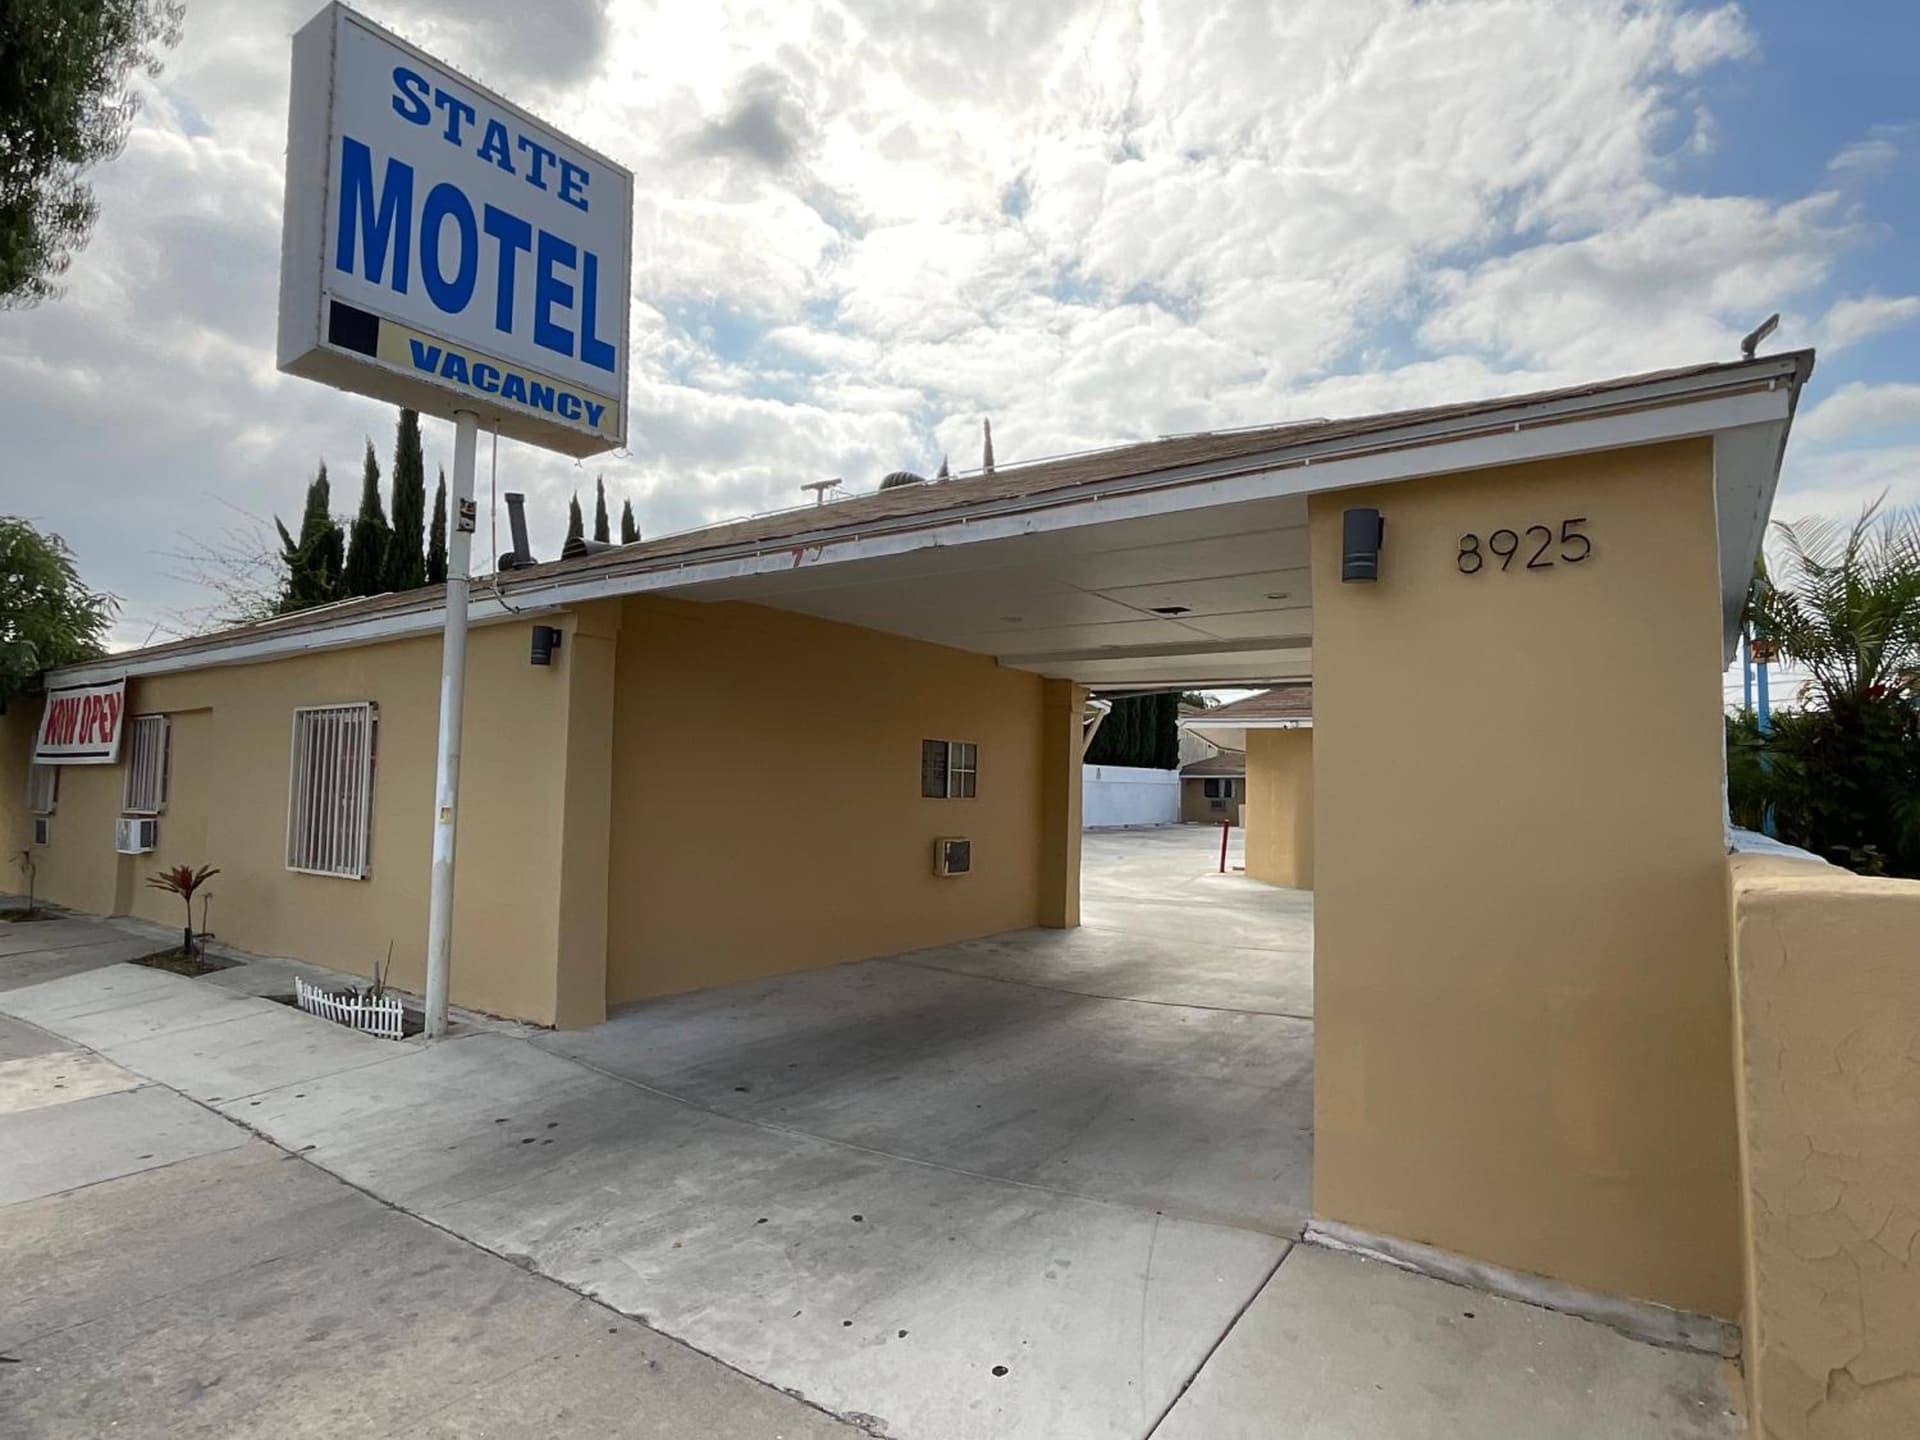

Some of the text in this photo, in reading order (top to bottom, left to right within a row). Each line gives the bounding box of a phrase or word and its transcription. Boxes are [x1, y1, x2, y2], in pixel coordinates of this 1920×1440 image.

[392, 67, 590, 212] STATE
[336, 136, 616, 373] MOTEL
[409, 339, 605, 427] VACANCY
[1457, 517, 1592, 574] 8925
[44, 697, 80, 745] NOW
